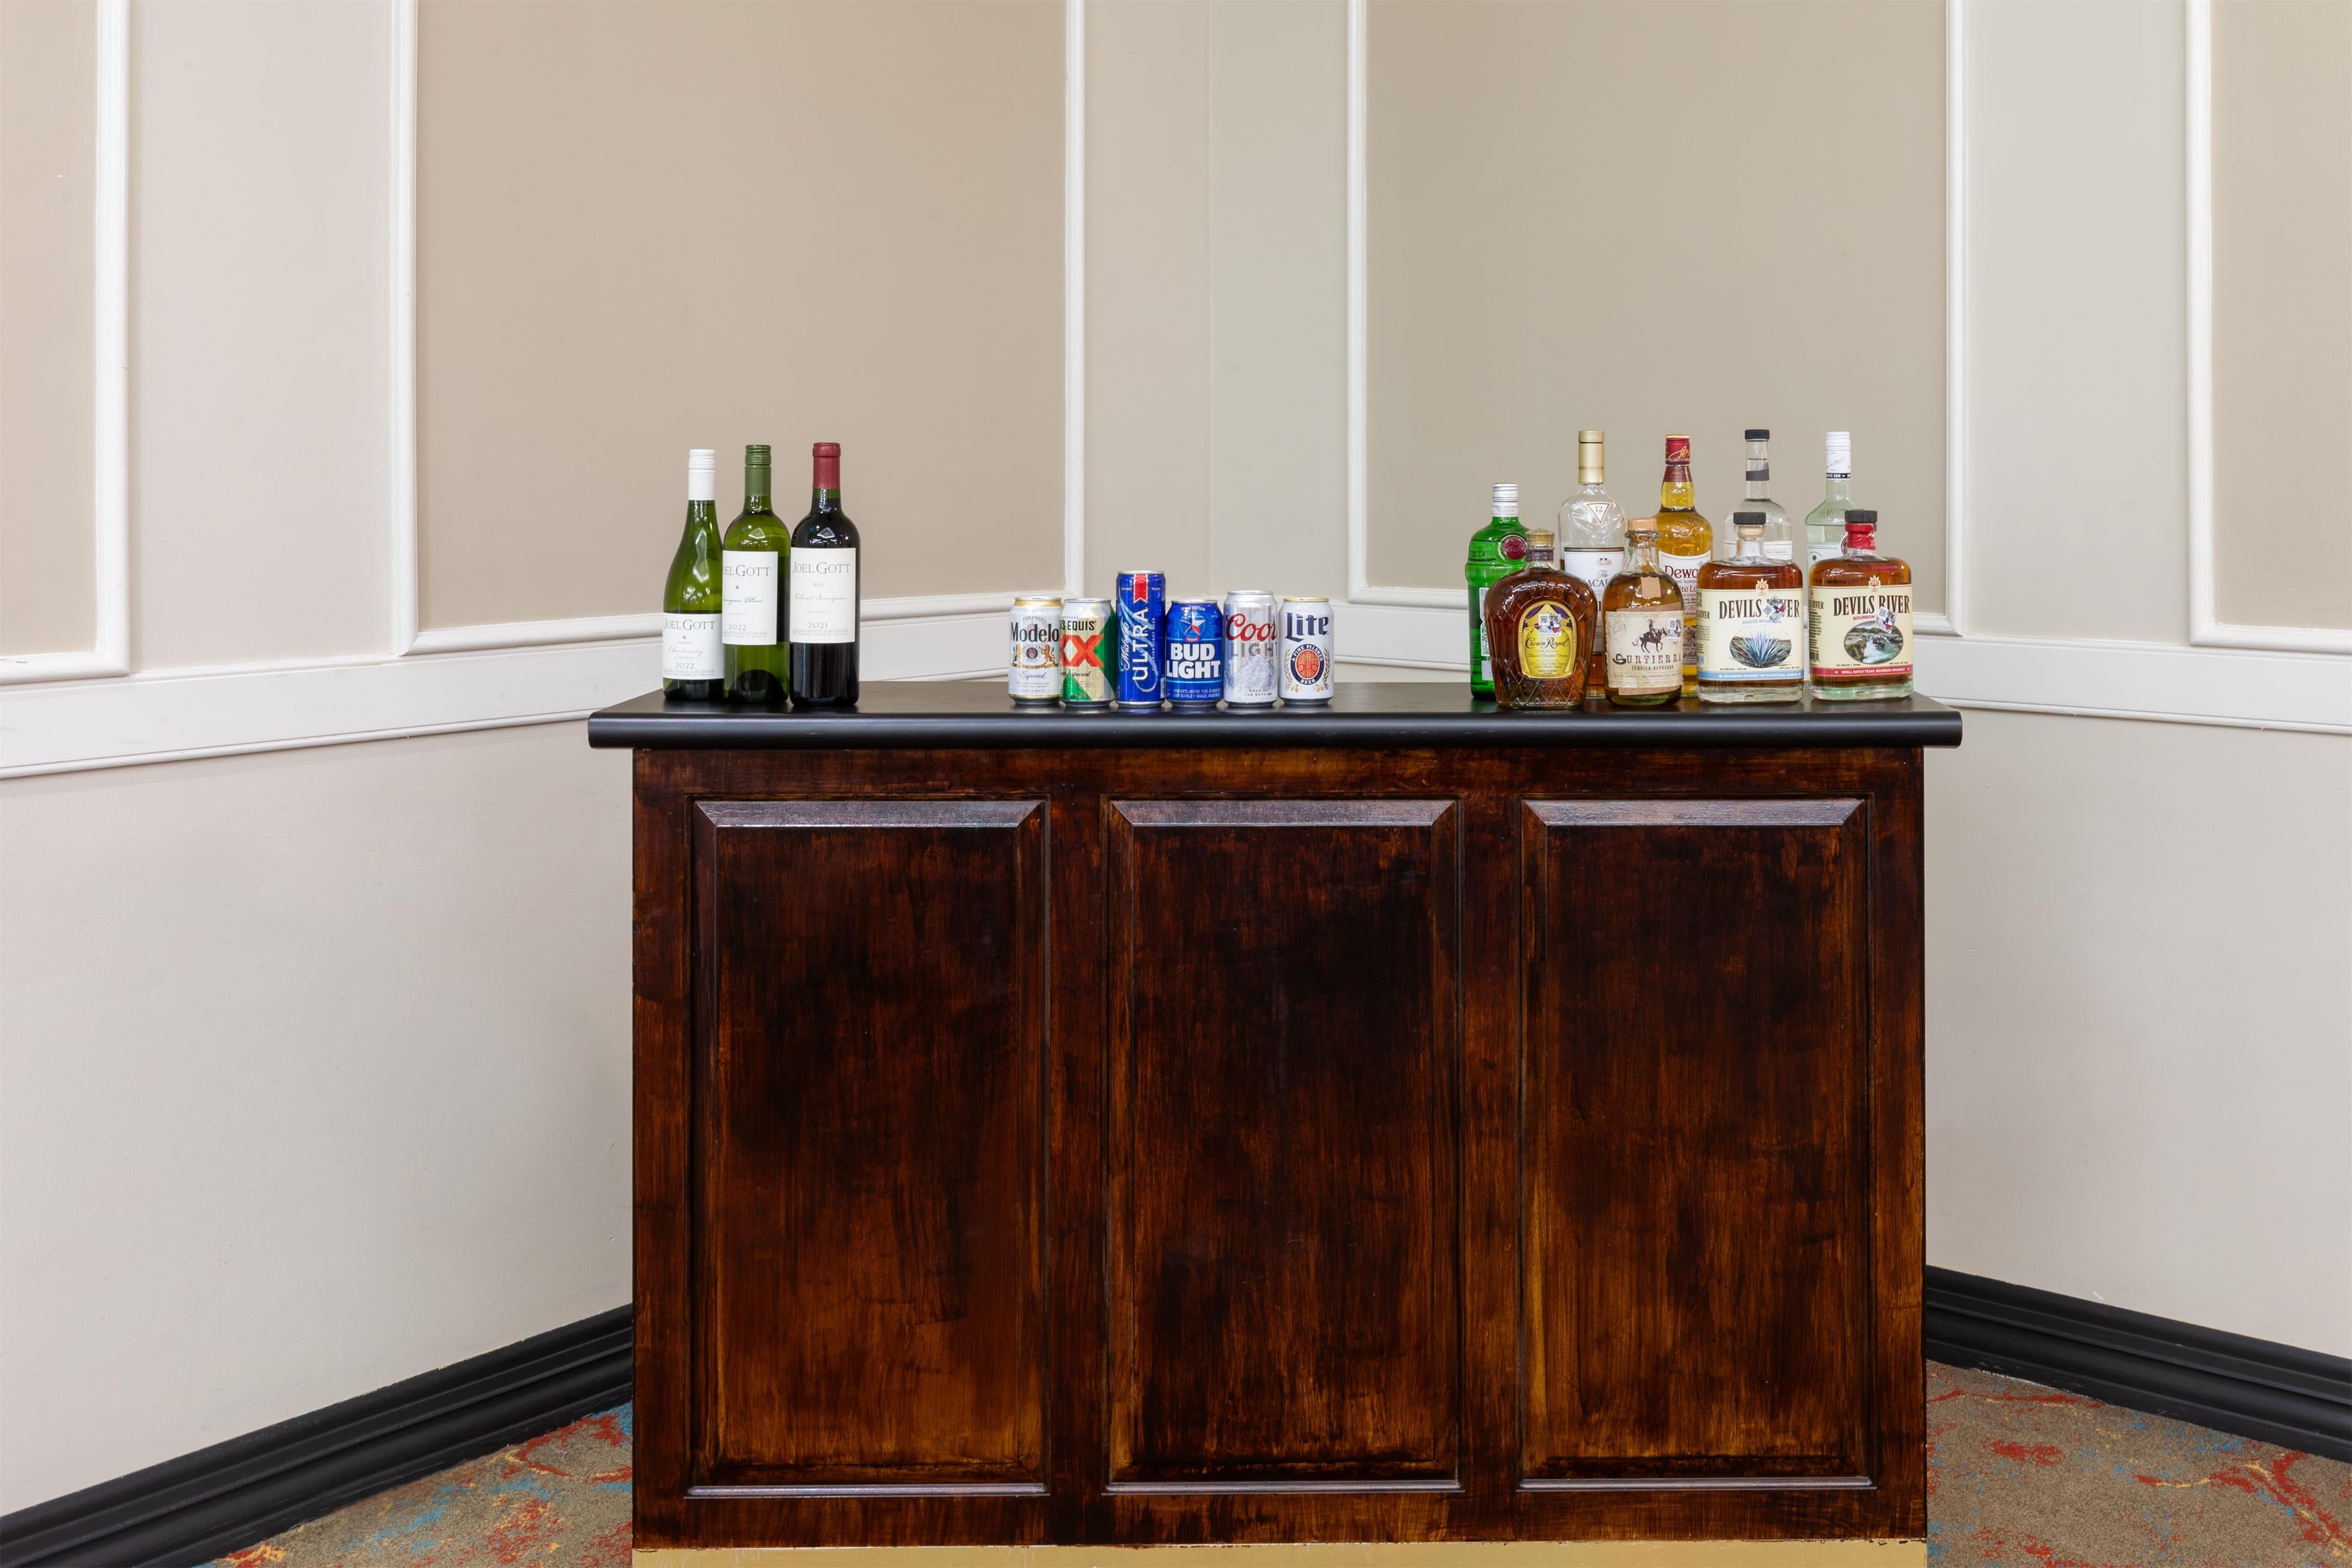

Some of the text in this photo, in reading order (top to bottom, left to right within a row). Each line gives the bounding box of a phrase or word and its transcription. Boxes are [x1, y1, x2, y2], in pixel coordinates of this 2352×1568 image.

[736, 565, 771, 577] GOTT
[793, 561, 851, 574] JOEL GOTT
[1719, 599, 1762, 619] DEVILS
[1834, 595, 1910, 616] DEVILS RIVER
[664, 618, 716, 630] JOEL GOTT
[1010, 622, 1059, 642] Modelo
[1067, 620, 1094, 632] EQUIS
[1285, 612, 1328, 642] Lite
[1132, 608, 1148, 680] ULTRA
[1526, 636, 1569, 649] Crown Royal
[1171, 643, 1215, 661] BUD
[1306, 645, 1324, 661] PILSNER
[1019, 670, 1046, 681] Especial
[1166, 660, 1220, 679] LIGHT
